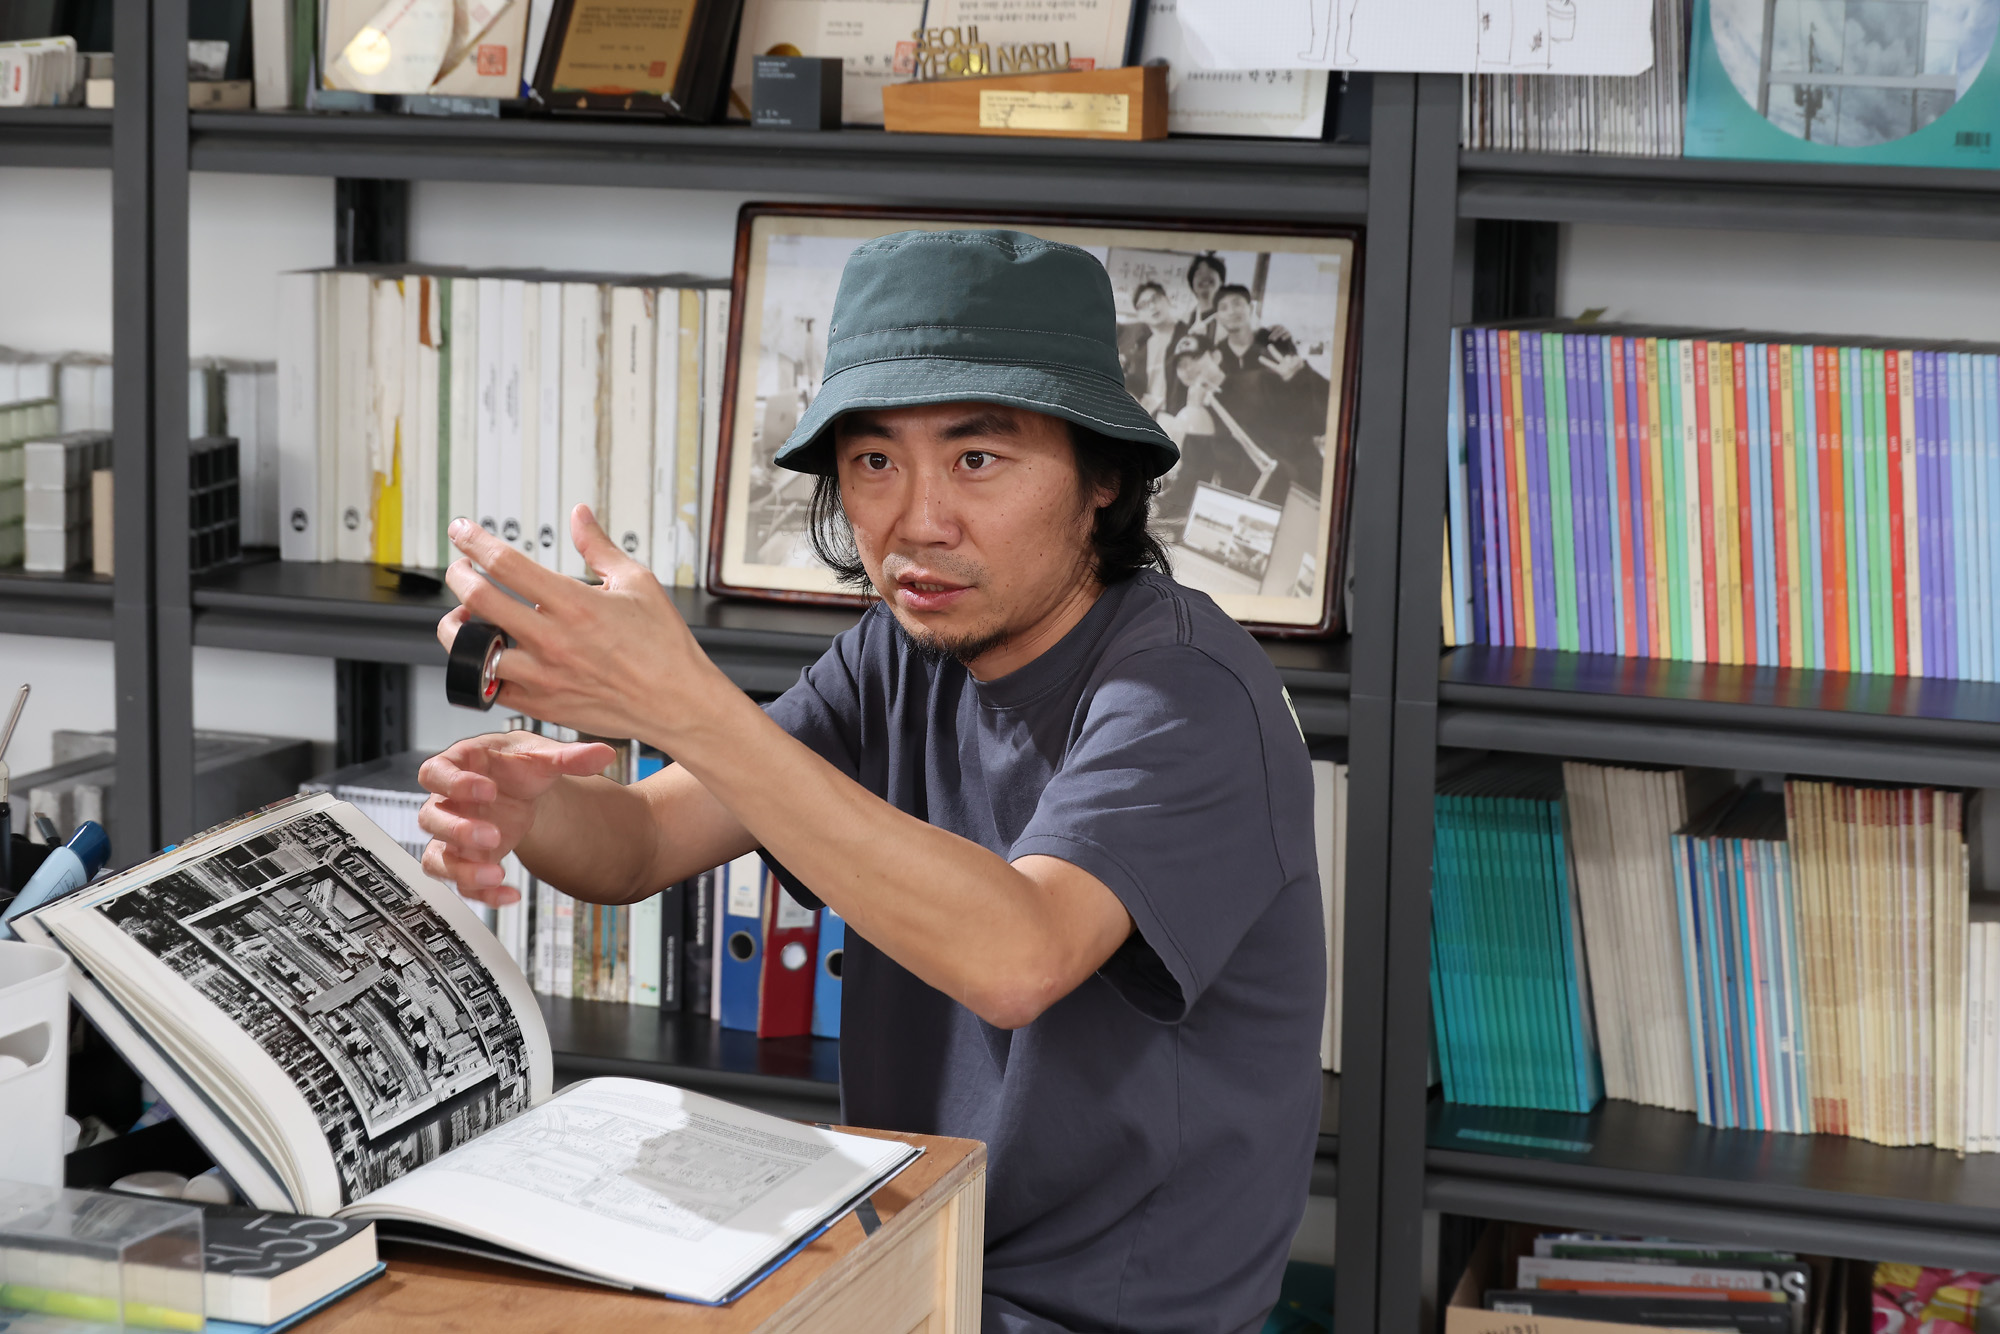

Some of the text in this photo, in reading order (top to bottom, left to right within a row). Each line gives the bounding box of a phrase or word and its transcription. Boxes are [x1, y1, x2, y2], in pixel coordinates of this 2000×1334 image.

[911, 25, 981, 49] SEOUL
[911, 42, 1072, 81] YEOUI NARU
